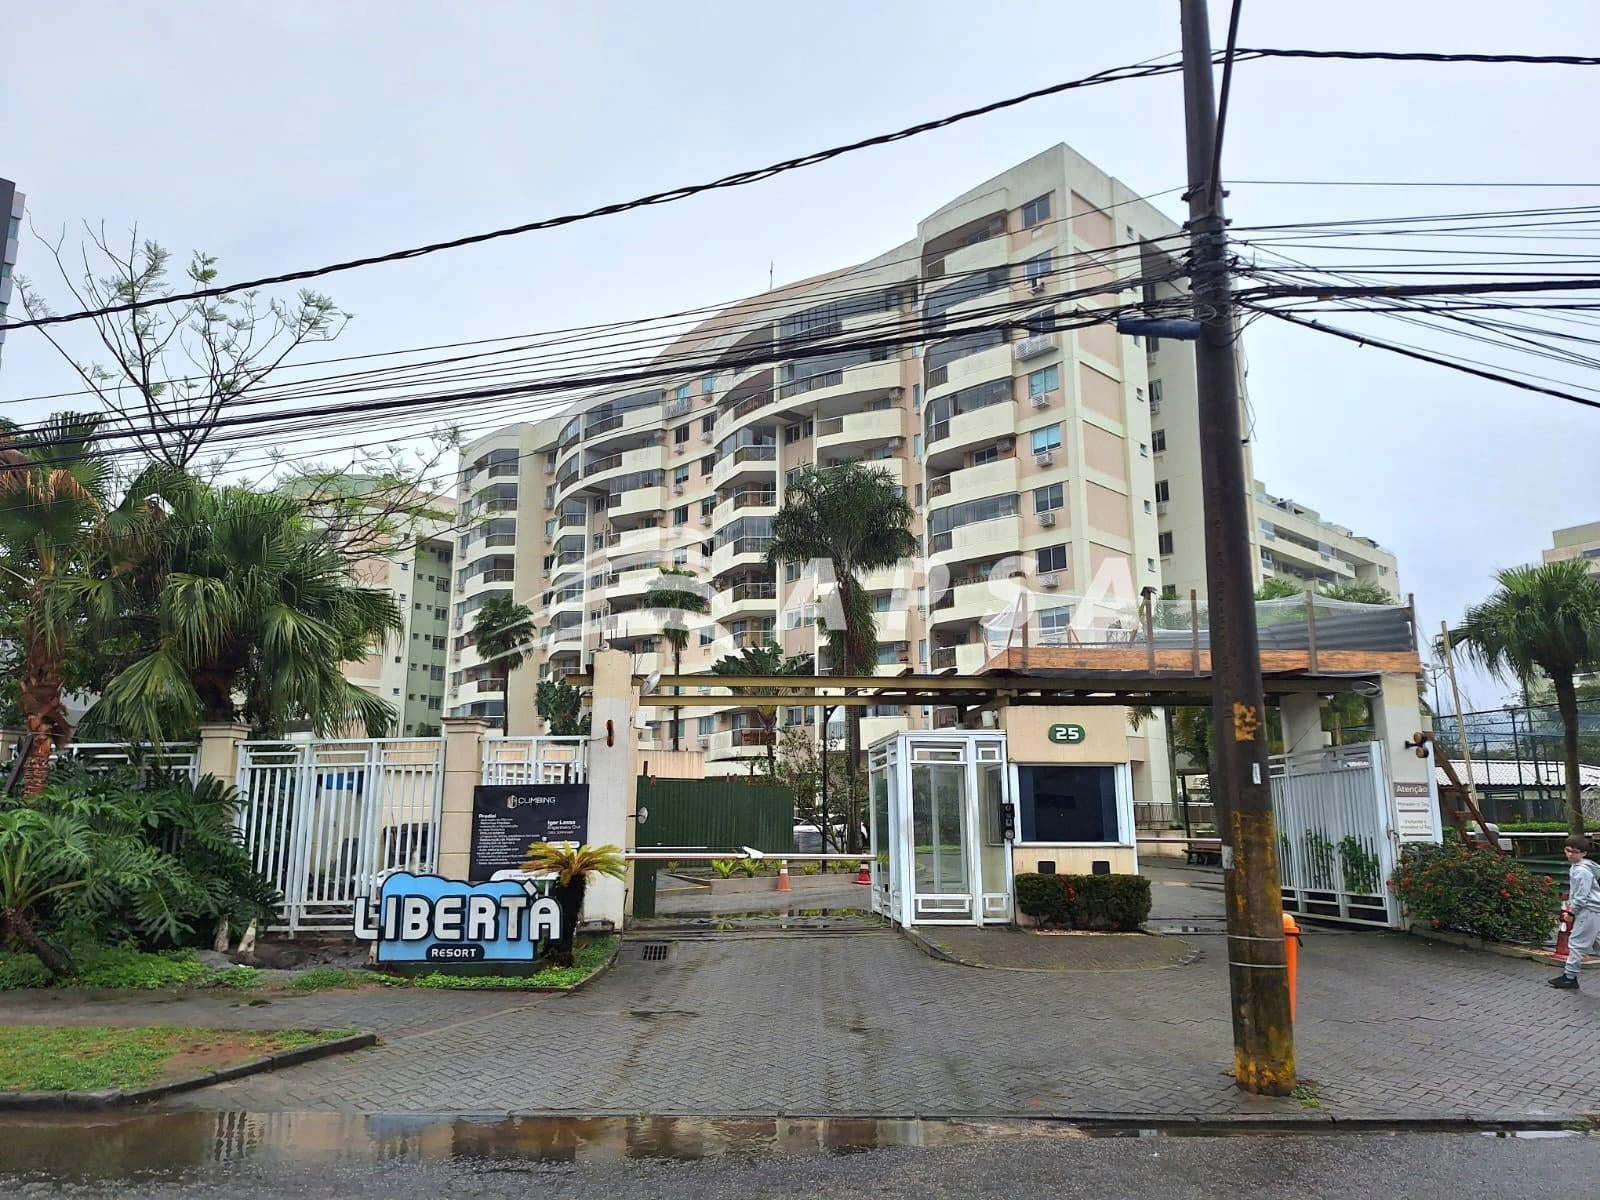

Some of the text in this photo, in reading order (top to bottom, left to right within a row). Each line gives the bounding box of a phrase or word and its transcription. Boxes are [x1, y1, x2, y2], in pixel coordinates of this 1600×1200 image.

[1055, 727, 1080, 740] 25
[1396, 785, 1428, 794] Atenção
[431, 948, 477, 958] RESORT
